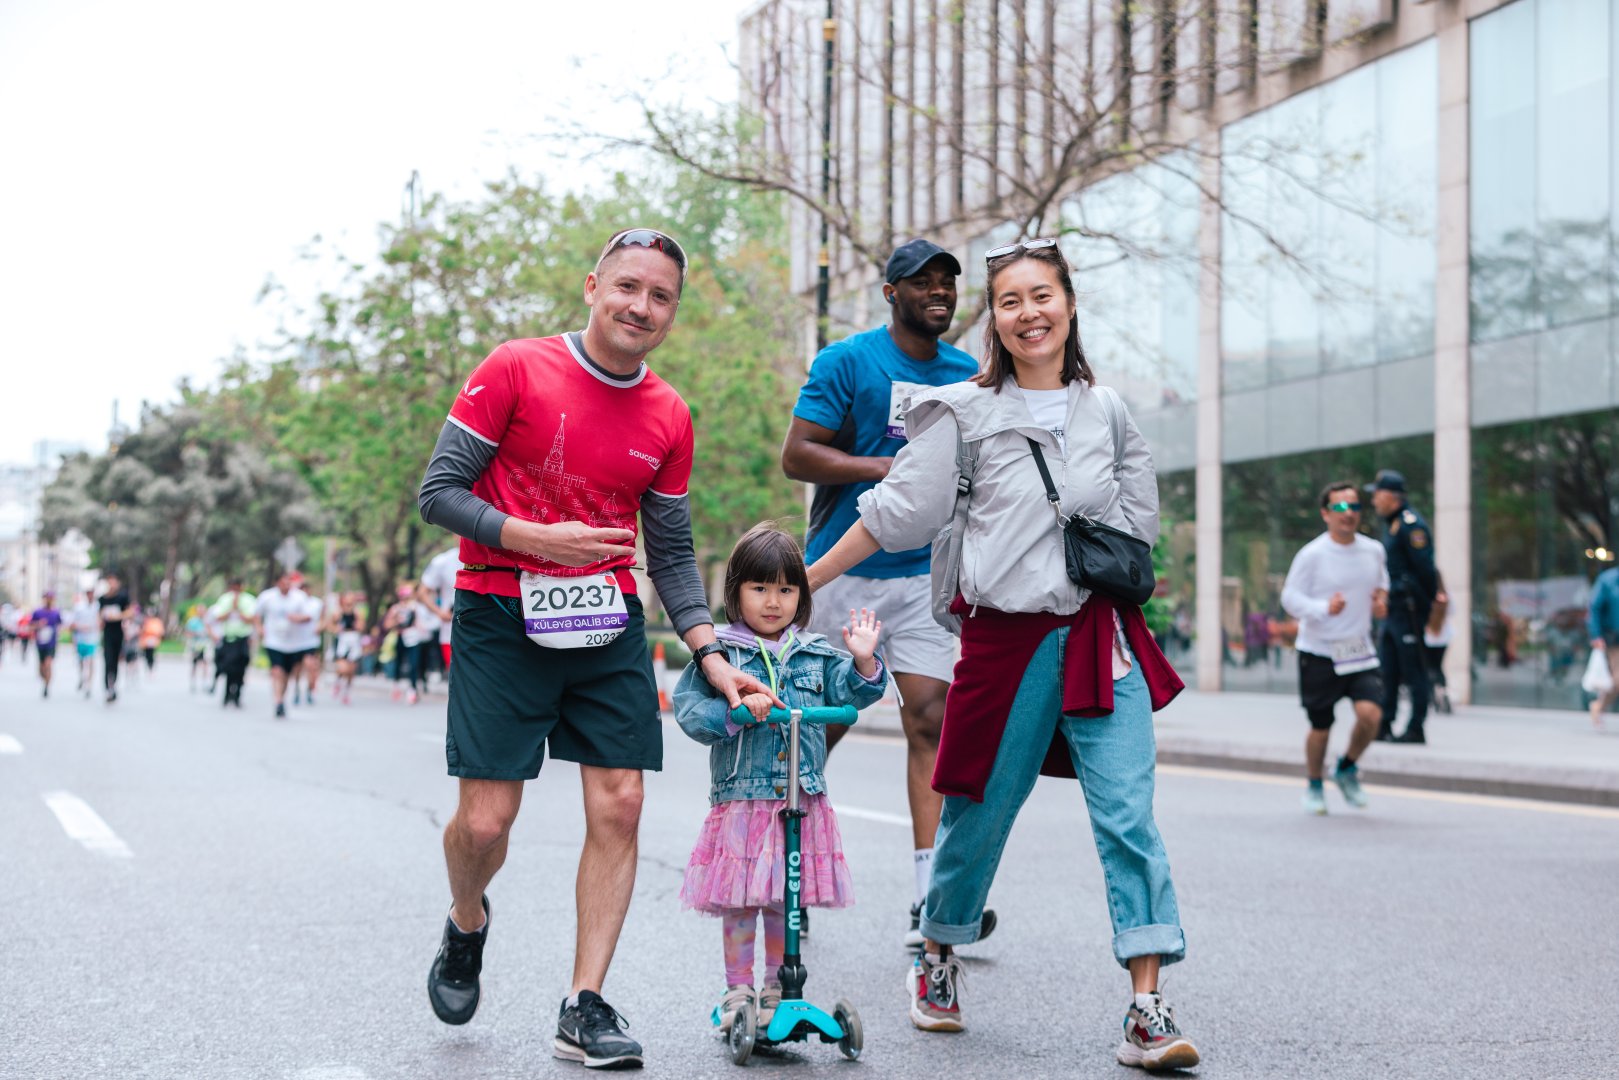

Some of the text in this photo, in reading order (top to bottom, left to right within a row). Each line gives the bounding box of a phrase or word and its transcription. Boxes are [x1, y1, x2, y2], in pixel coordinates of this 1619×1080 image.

[629, 448, 660, 466] saucony
[529, 585, 616, 612] 20237
[574, 616, 601, 628] QALİB
[603, 616, 622, 625] GƏL
